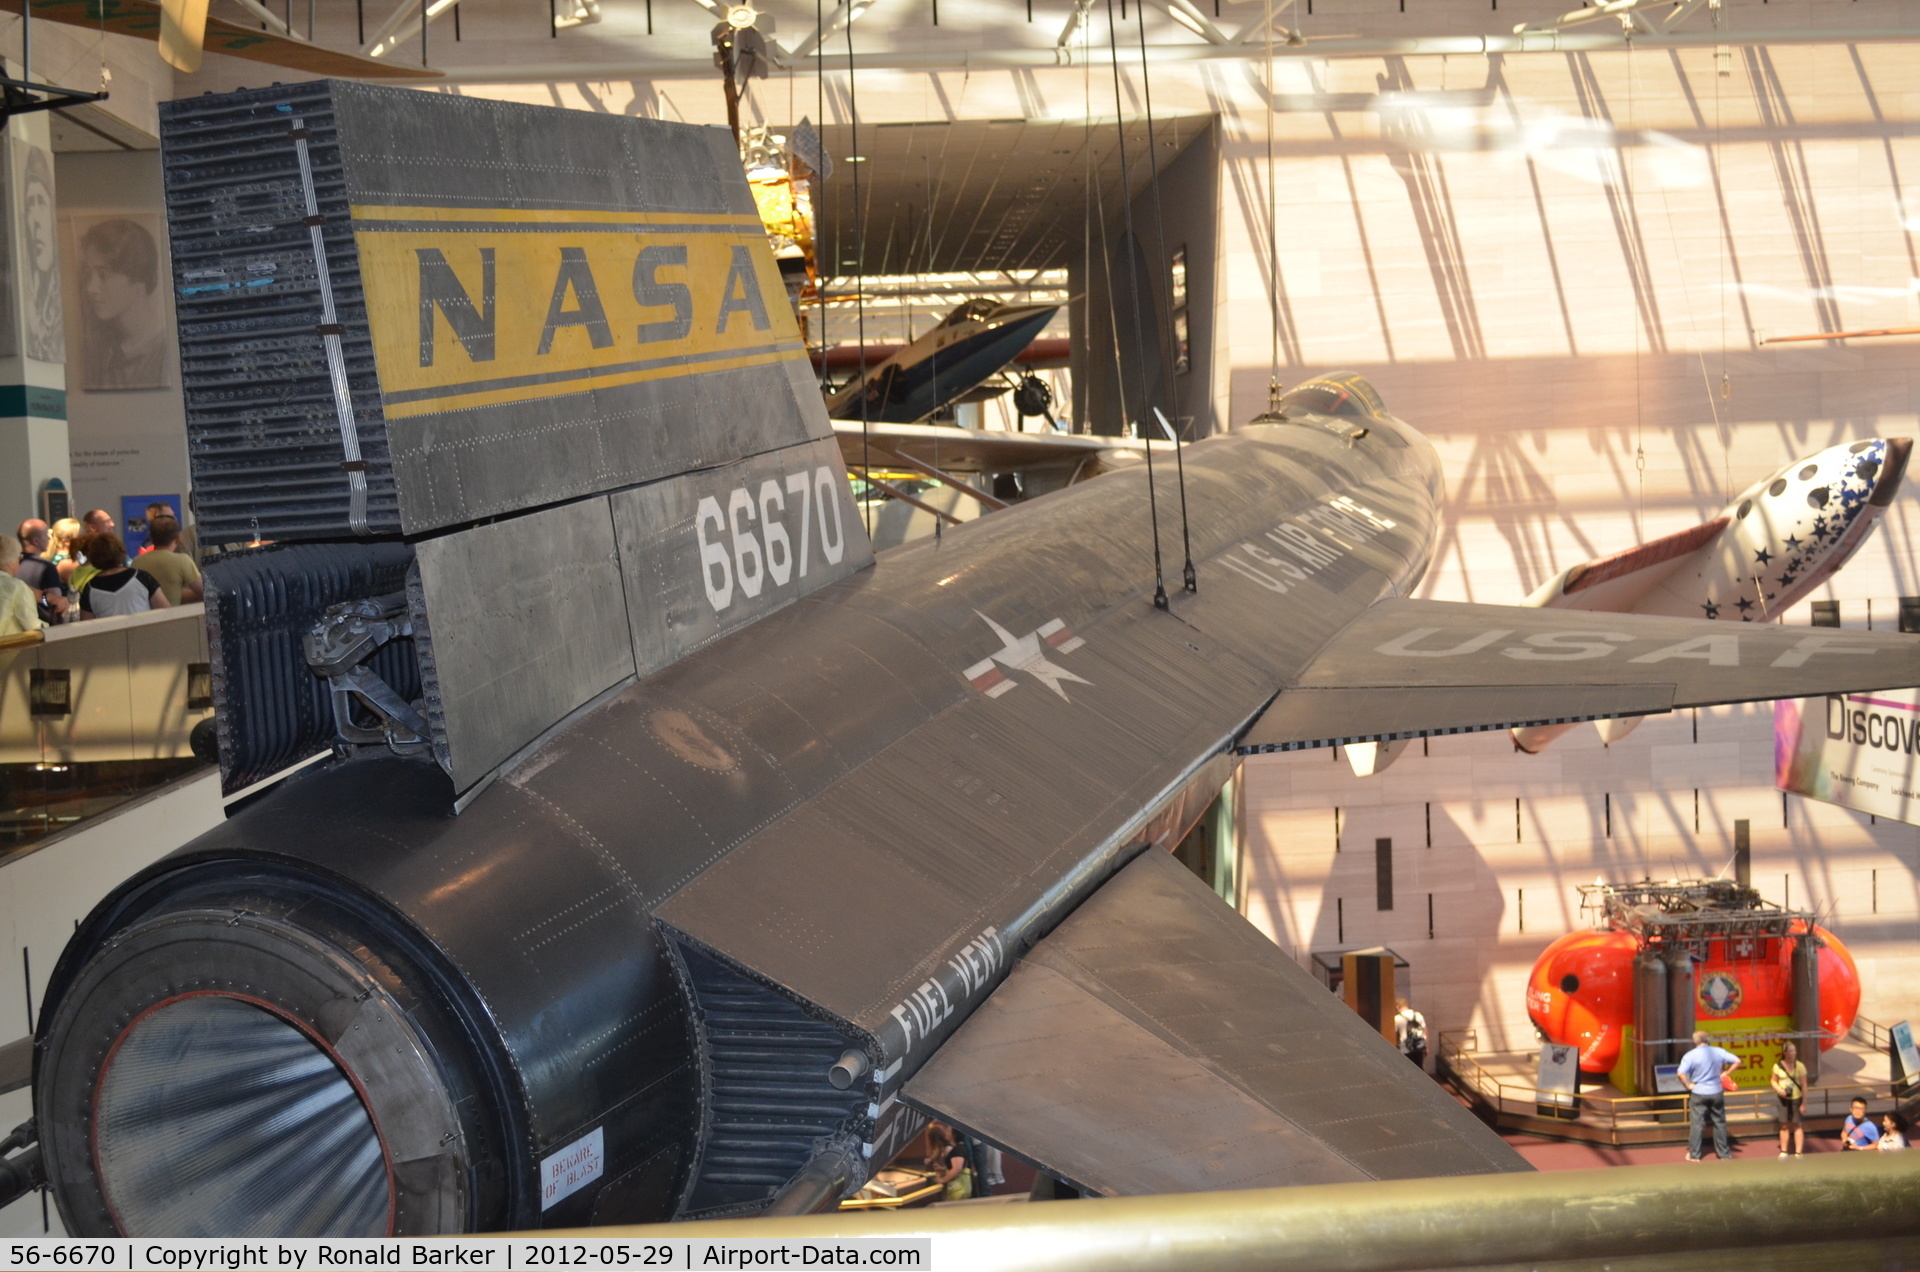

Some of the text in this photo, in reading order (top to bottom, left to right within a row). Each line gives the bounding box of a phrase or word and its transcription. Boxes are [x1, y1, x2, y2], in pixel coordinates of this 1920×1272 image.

[414, 245, 772, 368] NASA
[695, 465, 845, 612] 66670
[1265, 522, 1344, 571] AIR
[1296, 495, 1397, 551] FORCE
[1373, 626, 1915, 669] USAF
[890, 925, 1004, 1054] FUEL VENT
[545, 1156, 600, 1199] OF BLAST
[552, 1143, 594, 1178] BEWARE
